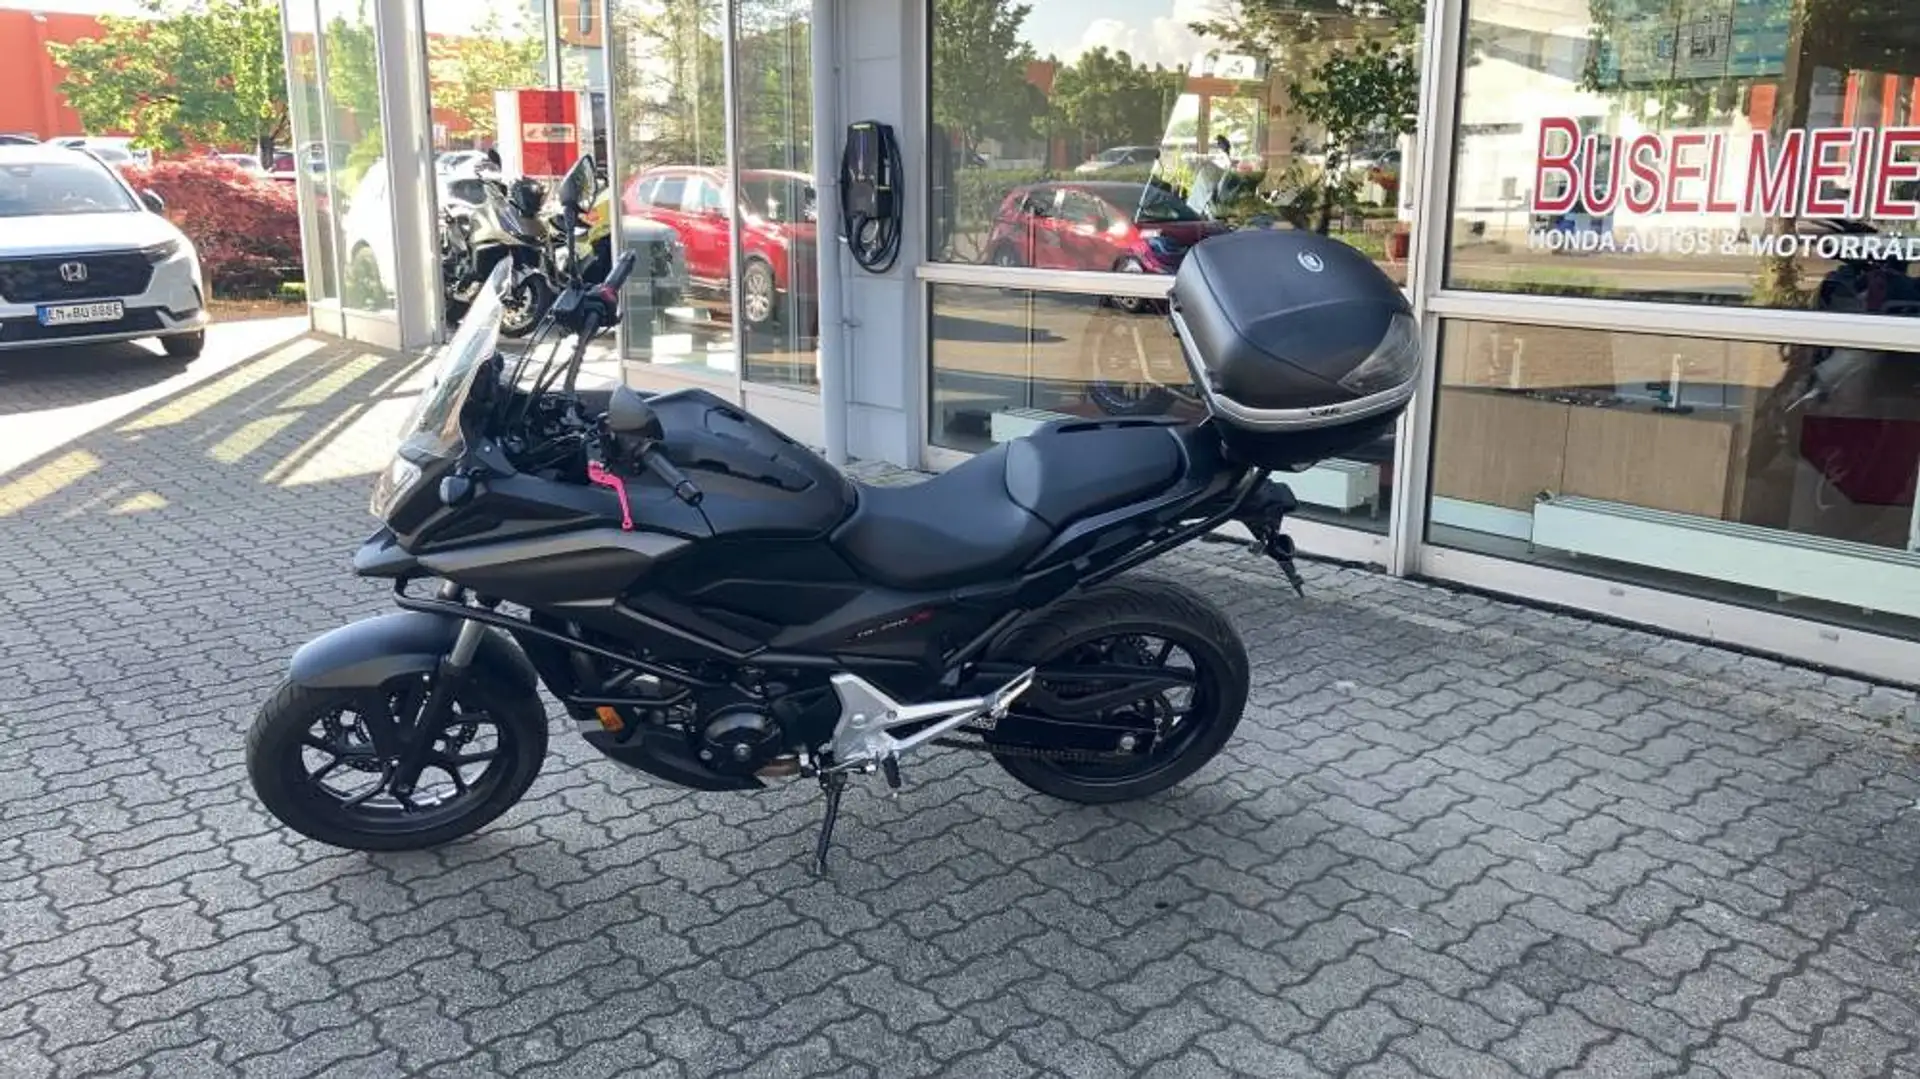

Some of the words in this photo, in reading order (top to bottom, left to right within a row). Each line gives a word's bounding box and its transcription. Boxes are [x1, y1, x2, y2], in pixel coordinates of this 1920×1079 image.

[1529, 228, 1616, 252] HONDA
[1623, 229, 1712, 255] AUTOS
[1720, 234, 1739, 255] &
